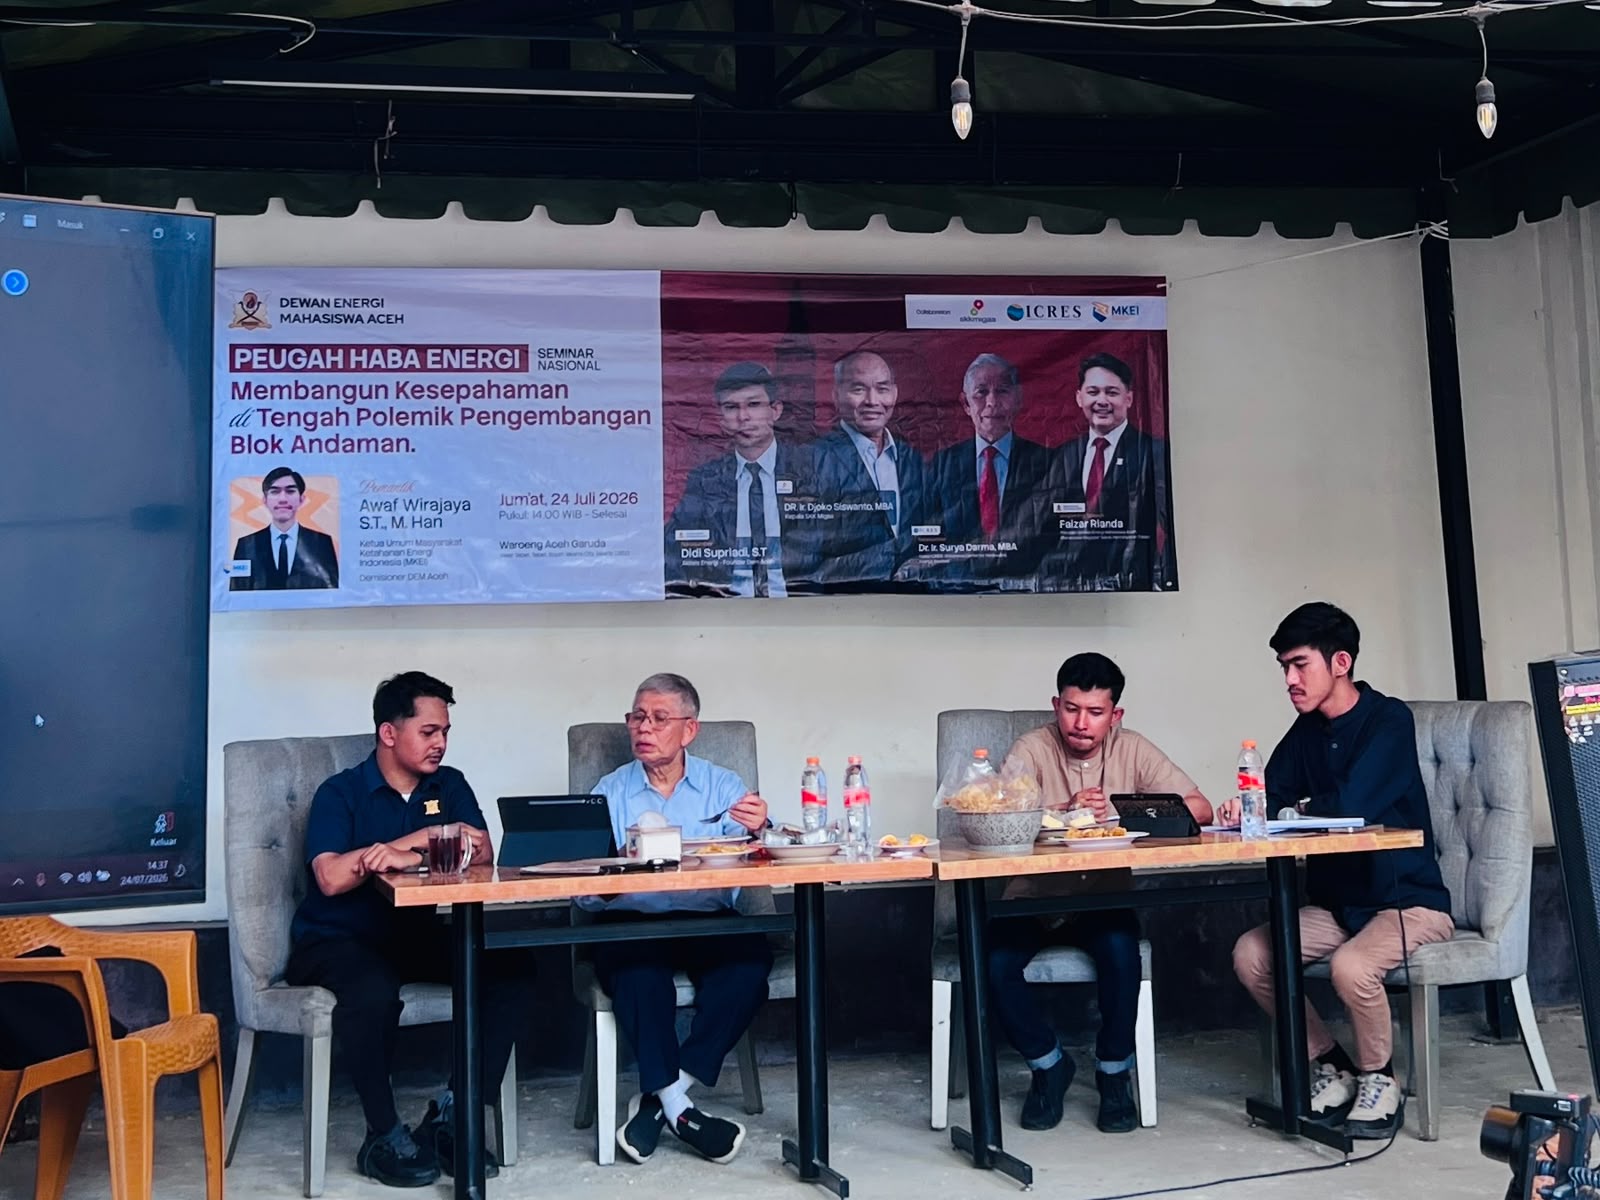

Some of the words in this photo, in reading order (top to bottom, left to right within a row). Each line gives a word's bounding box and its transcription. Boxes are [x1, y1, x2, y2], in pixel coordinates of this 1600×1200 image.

[279, 297, 330, 308] DEWAN
[334, 298, 385, 309] ENERGI
[1026, 304, 1082, 319] ICRES
[1111, 305, 1140, 316] MKEI
[279, 313, 364, 324] MAHASISWA
[367, 313, 405, 325] ACEH
[235, 348, 344, 370] PEUGAH
[350, 348, 421, 370] HABA
[427, 348, 520, 369] ENERGI
[537, 347, 594, 359] SEMINAR
[537, 360, 601, 371] NASIONAL
[231, 379, 389, 405] Membangun
[395, 379, 569, 404] Kesepahaman
[229, 407, 255, 428] di
[257, 406, 350, 432] Tengah
[356, 406, 454, 427] Polemik
[460, 405, 651, 431] Pengembangan
[231, 434, 284, 455] Blok
[290, 433, 416, 454] Andaman.
[550, 492, 570, 506] 24
[573, 491, 596, 506] Juli
[599, 491, 639, 505] 2026
[359, 498, 399, 512] Awaf
[403, 497, 471, 515] Wirajaya
[807, 502, 833, 513] Djoko
[875, 502, 894, 511] MBA
[499, 510, 529, 520] Pukul:
[562, 509, 583, 519] WIB
[592, 509, 628, 519] Selesai
[391, 516, 409, 529] M.
[412, 515, 443, 529] Han
[1090, 518, 1124, 529] Rianda
[360, 539, 385, 548] Ketua
[386, 539, 414, 548] Umum
[415, 538, 463, 550] Masyarakat
[499, 540, 543, 551] Waroeng
[545, 539, 570, 549] Aceh
[571, 539, 607, 549] Garuda
[939, 543, 965, 554] Surya
[997, 542, 1018, 551] MBA
[360, 549, 405, 558] Ketahanan
[406, 548, 434, 558] Energi
[681, 547, 702, 559] Didi
[752, 547, 768, 558] S.T
[360, 558, 402, 567] Indonesia
[403, 558, 429, 568] (MKEI)
[360, 573, 406, 582] Demisioner
[407, 573, 426, 581] DEM
[427, 572, 449, 580] Aceh
[120, 873, 169, 887] 24/07/2026
